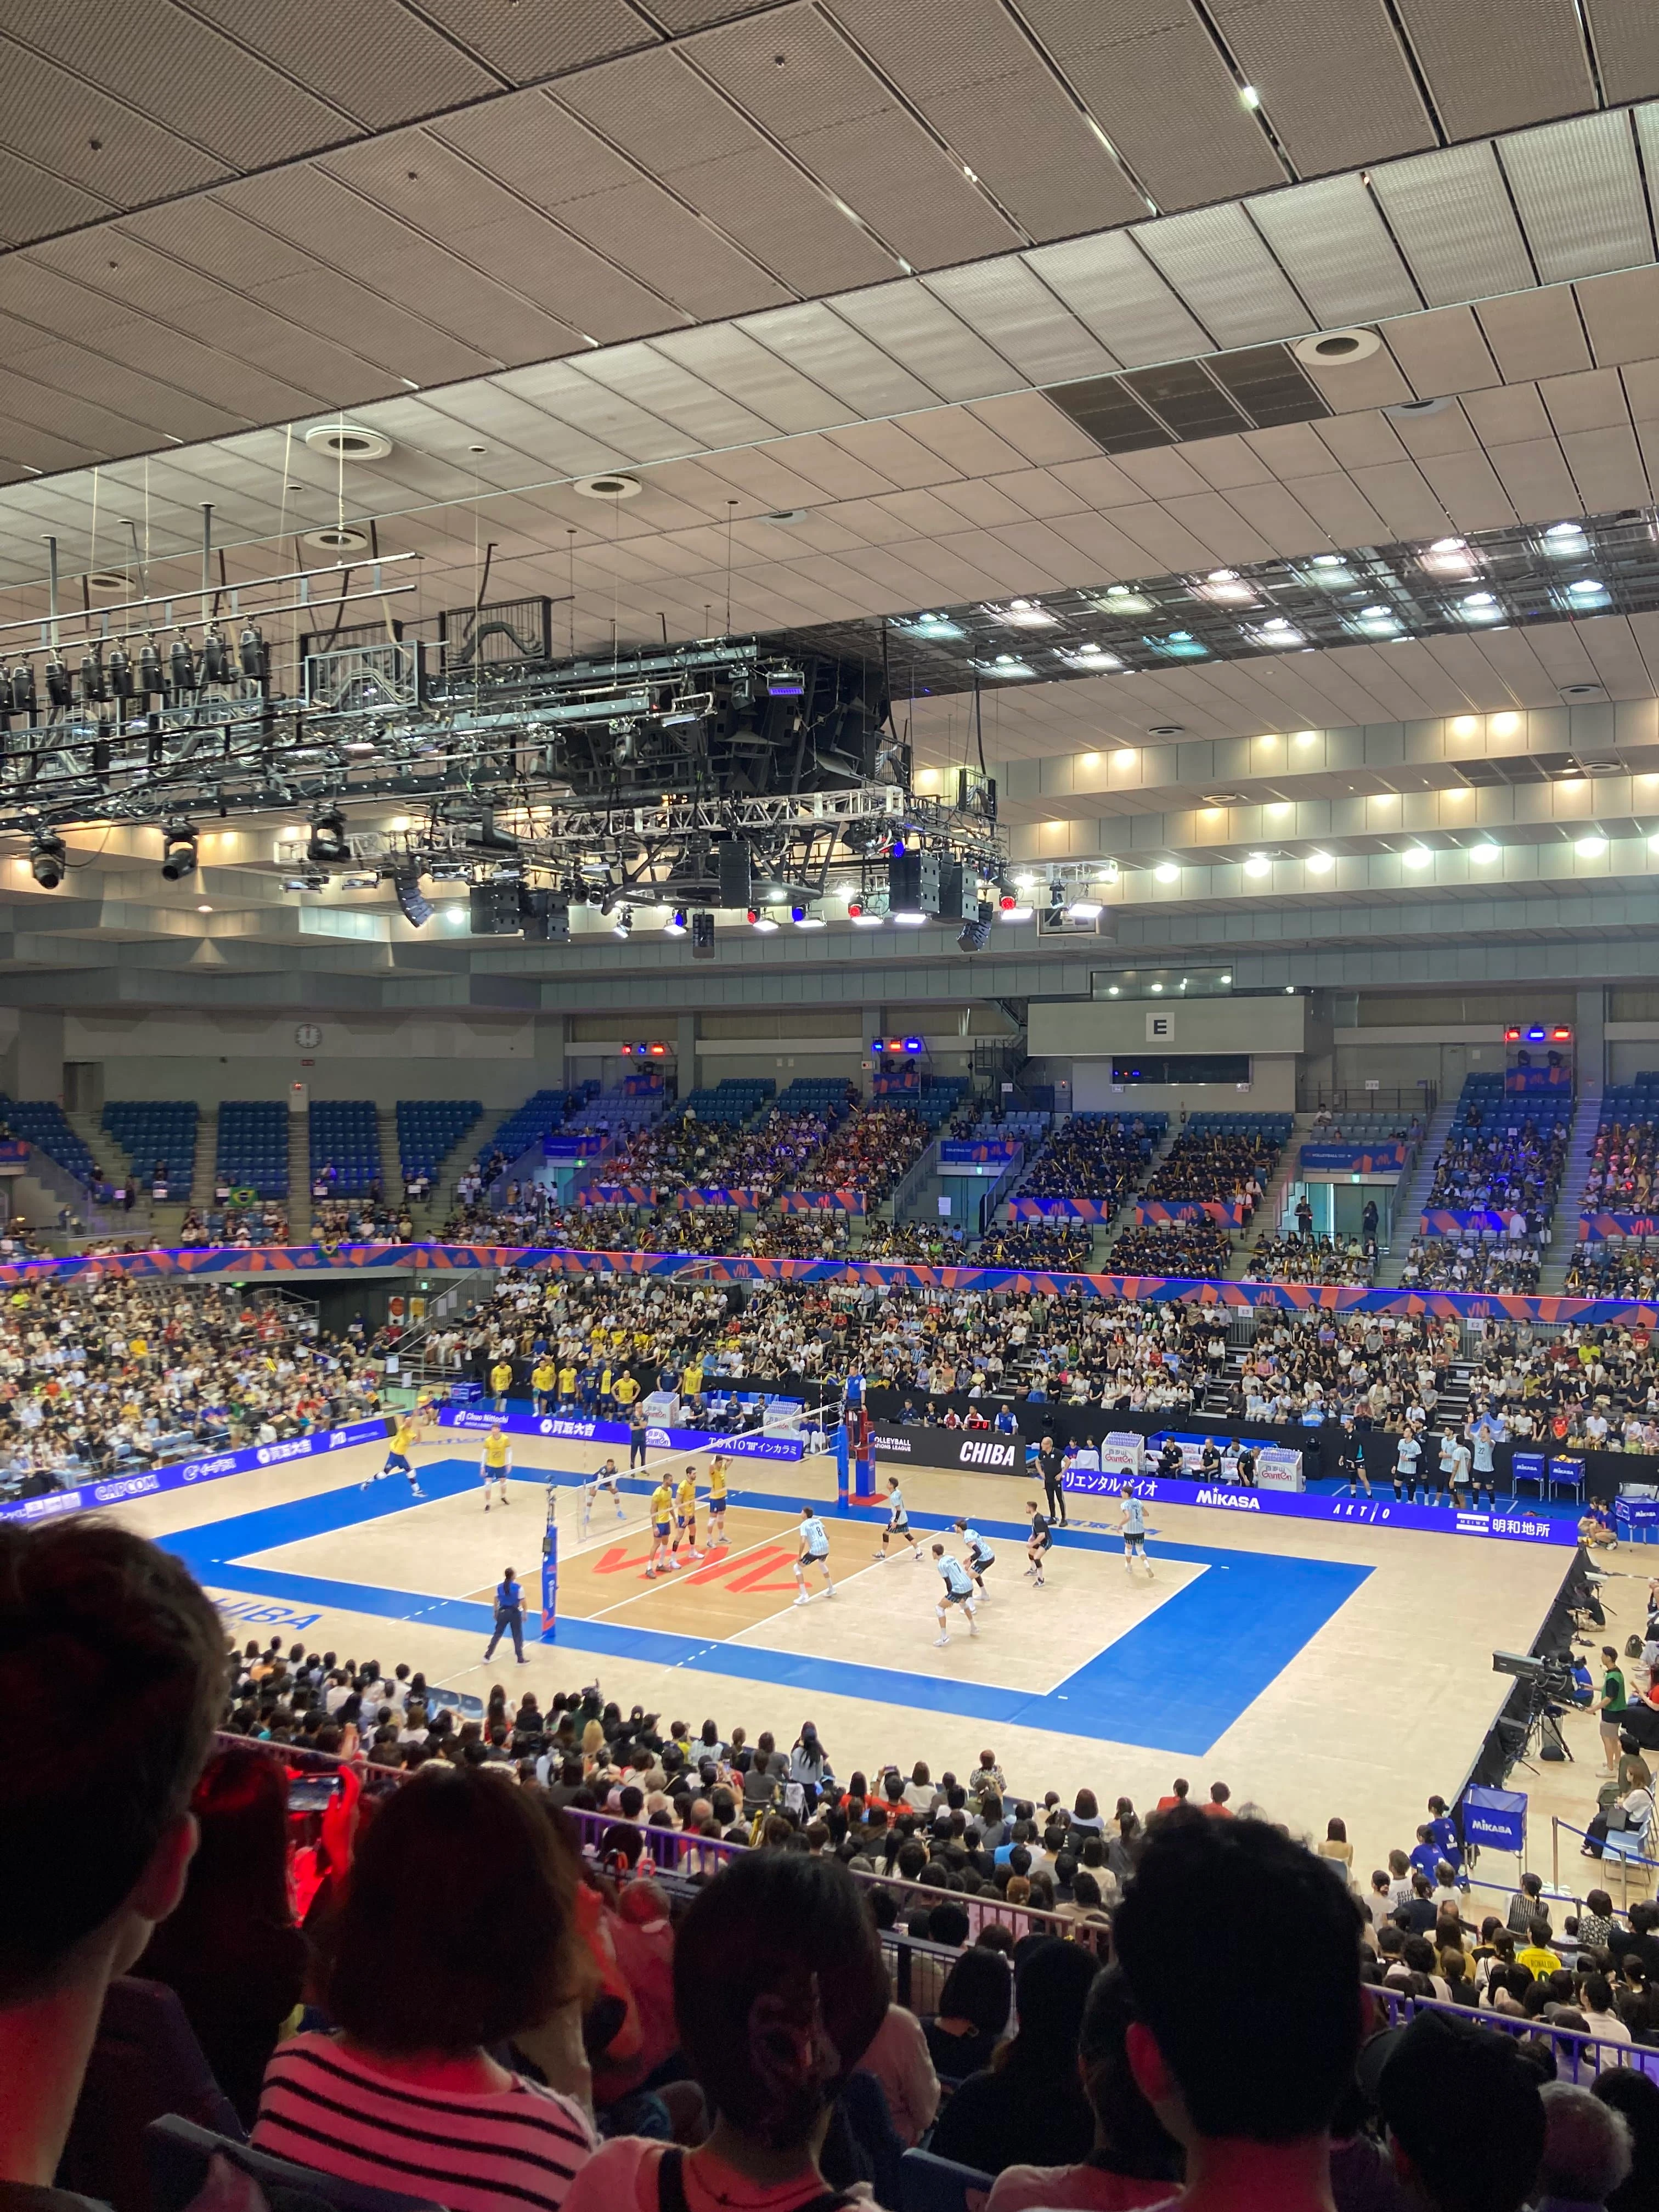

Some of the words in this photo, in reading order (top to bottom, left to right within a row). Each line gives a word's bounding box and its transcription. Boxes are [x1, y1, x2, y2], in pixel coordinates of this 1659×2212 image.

[1154, 1019, 1167, 1035] E
[758, 1442, 797, 1455] インカラミ
[874, 1436, 911, 1447] OLLEYBALL
[960, 1441, 1015, 1466] CHIBA
[94, 1474, 160, 1501] CAPCOM
[1062, 1472, 1158, 1497] リエンタルバイオ
[816, 1526, 823, 1537] 8
[1492, 1518, 1550, 1537] 明和地所
[592, 1543, 812, 1593] VNL
[953, 1562, 961, 1573] 7
[213, 1598, 324, 1630] HIBA
[1531, 1959, 1554, 1968] RONALDO
